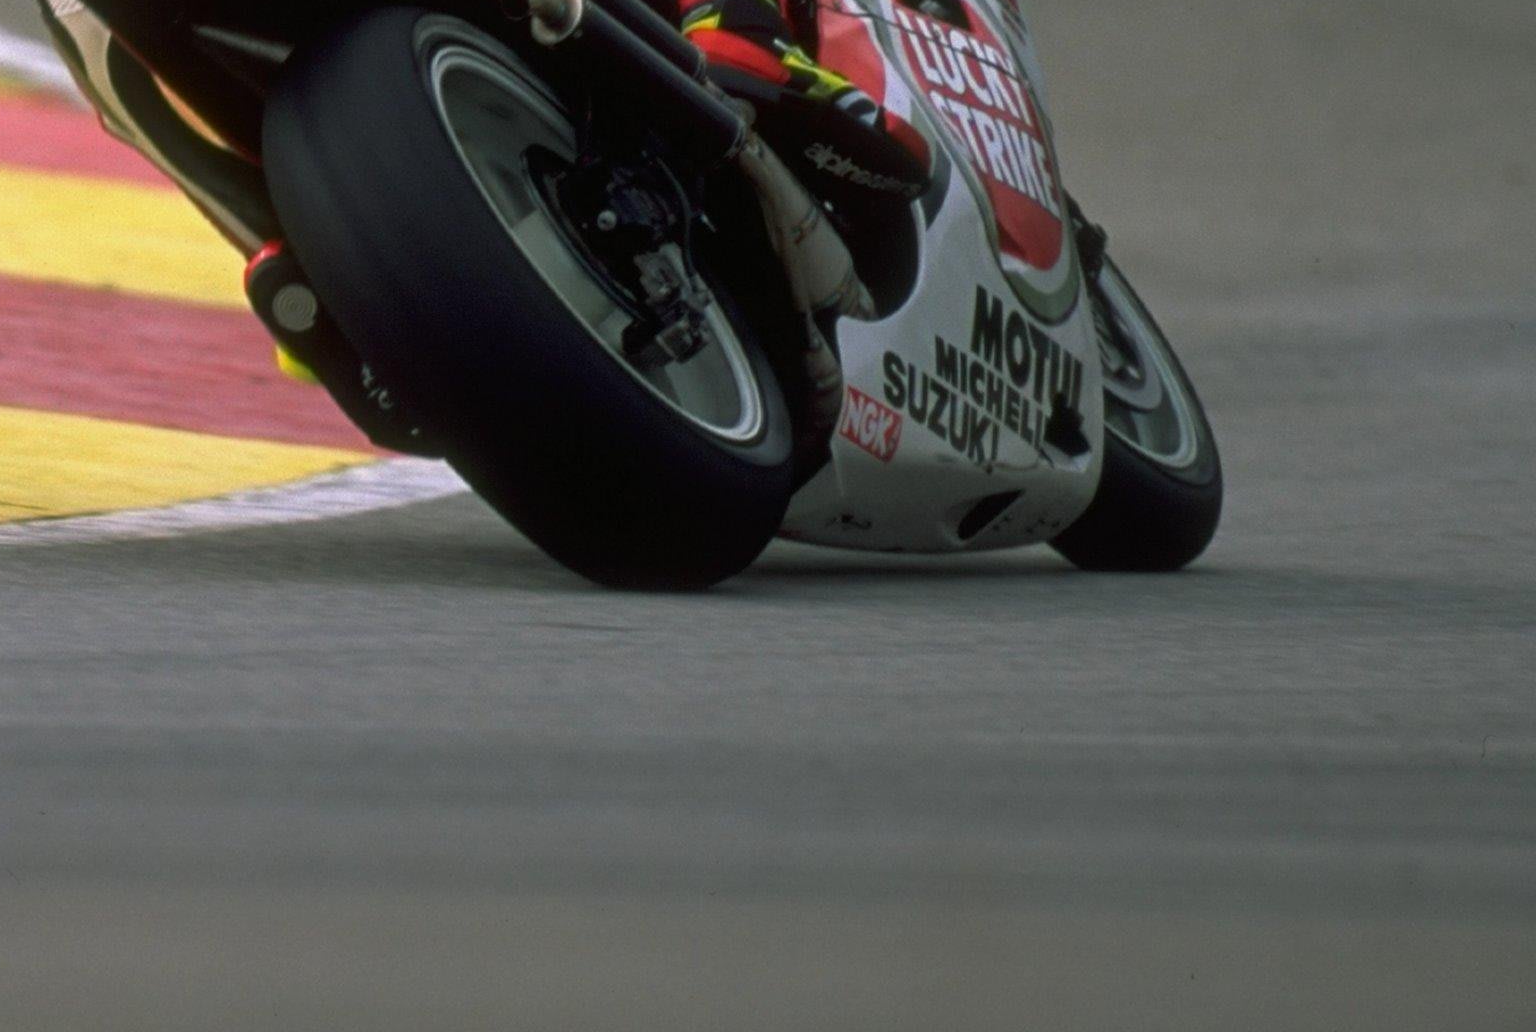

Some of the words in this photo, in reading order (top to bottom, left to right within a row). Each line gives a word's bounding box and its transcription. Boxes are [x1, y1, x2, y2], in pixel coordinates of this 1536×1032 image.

[897, 9, 1033, 127] LUCKY
[930, 90, 1061, 218] STRIKE
[840, 391, 896, 457] NGK
[883, 351, 1001, 466] SUZUKI
[935, 335, 1044, 450] MICHELI
